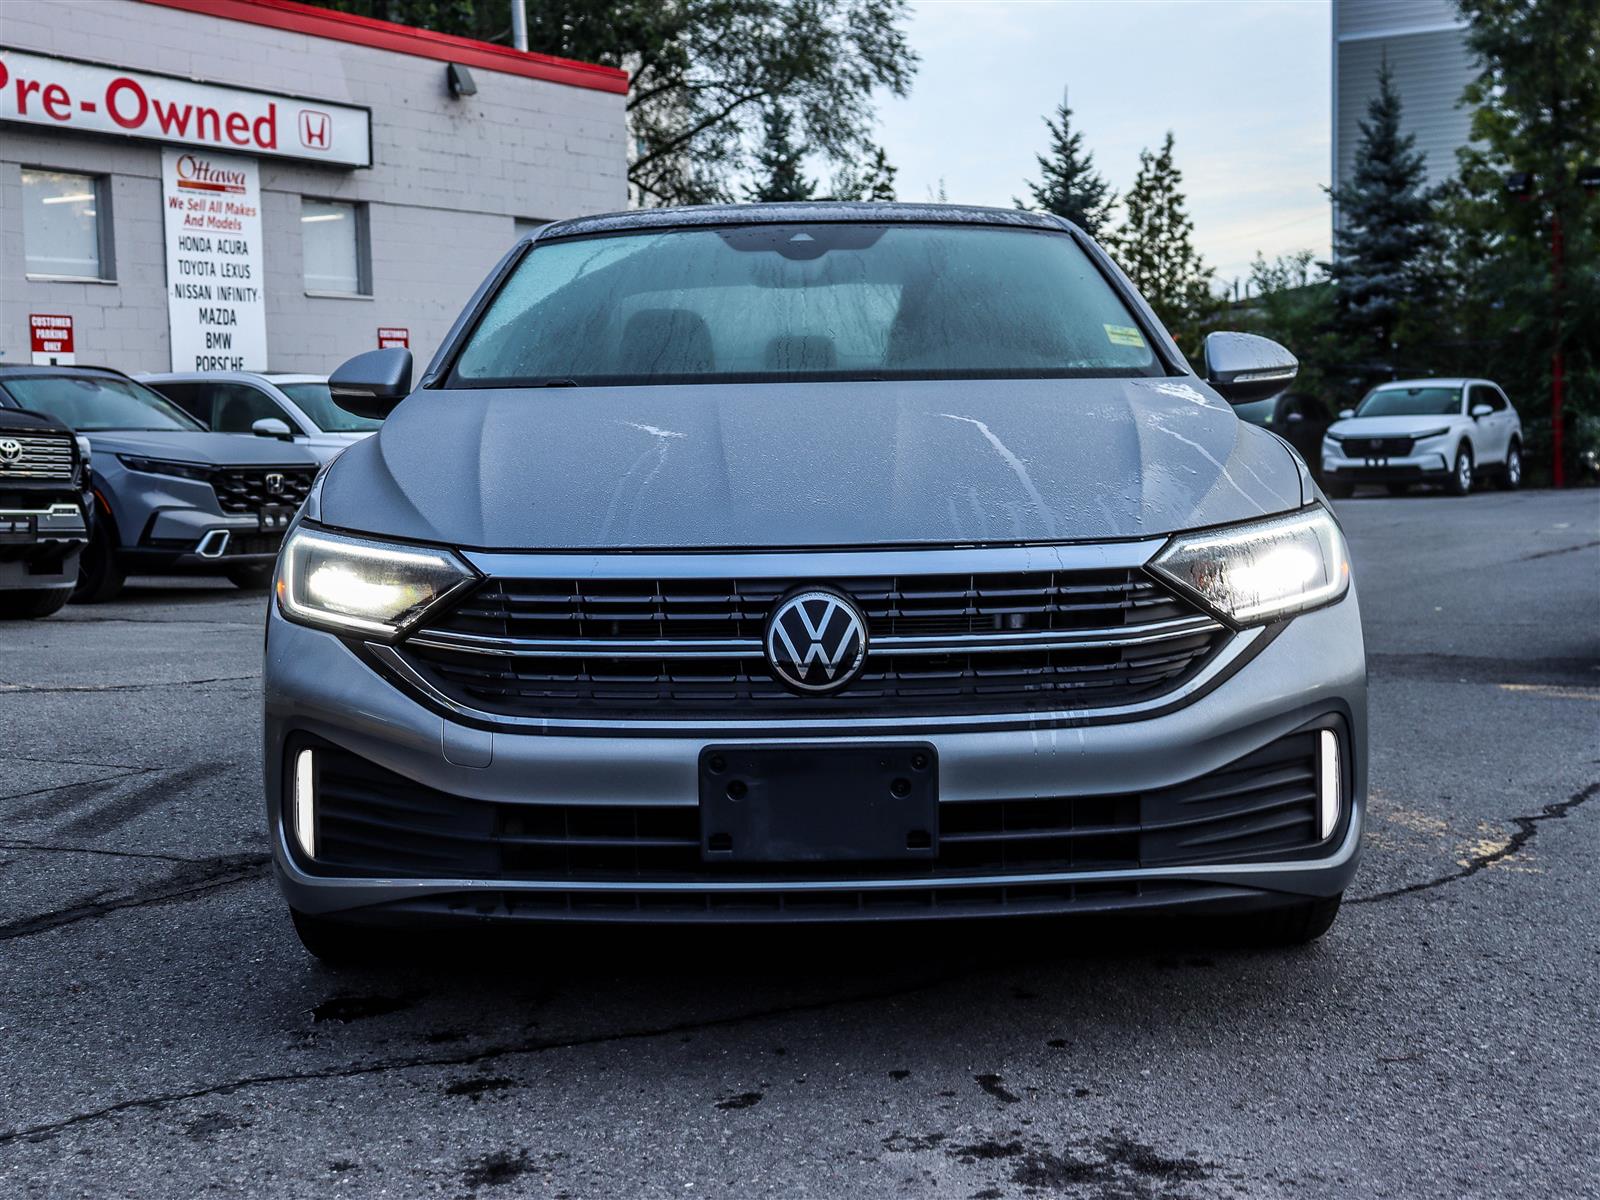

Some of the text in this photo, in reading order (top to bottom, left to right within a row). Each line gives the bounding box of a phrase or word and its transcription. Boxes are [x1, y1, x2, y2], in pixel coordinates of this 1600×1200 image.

[0, 60, 277, 150] re-Owned
[176, 153, 246, 185] Ottawa
[168, 196, 257, 217] We Sell All Makes
[183, 213, 242, 230] And Models
[178, 236, 249, 255] HONDA ACURA
[178, 259, 251, 279] TOYOTA LEXUS
[174, 283, 258, 302] NISSAN INFINITY
[199, 307, 237, 326] MAZDA
[206, 331, 232, 350] BMW
[195, 355, 244, 372] PORSCHE
